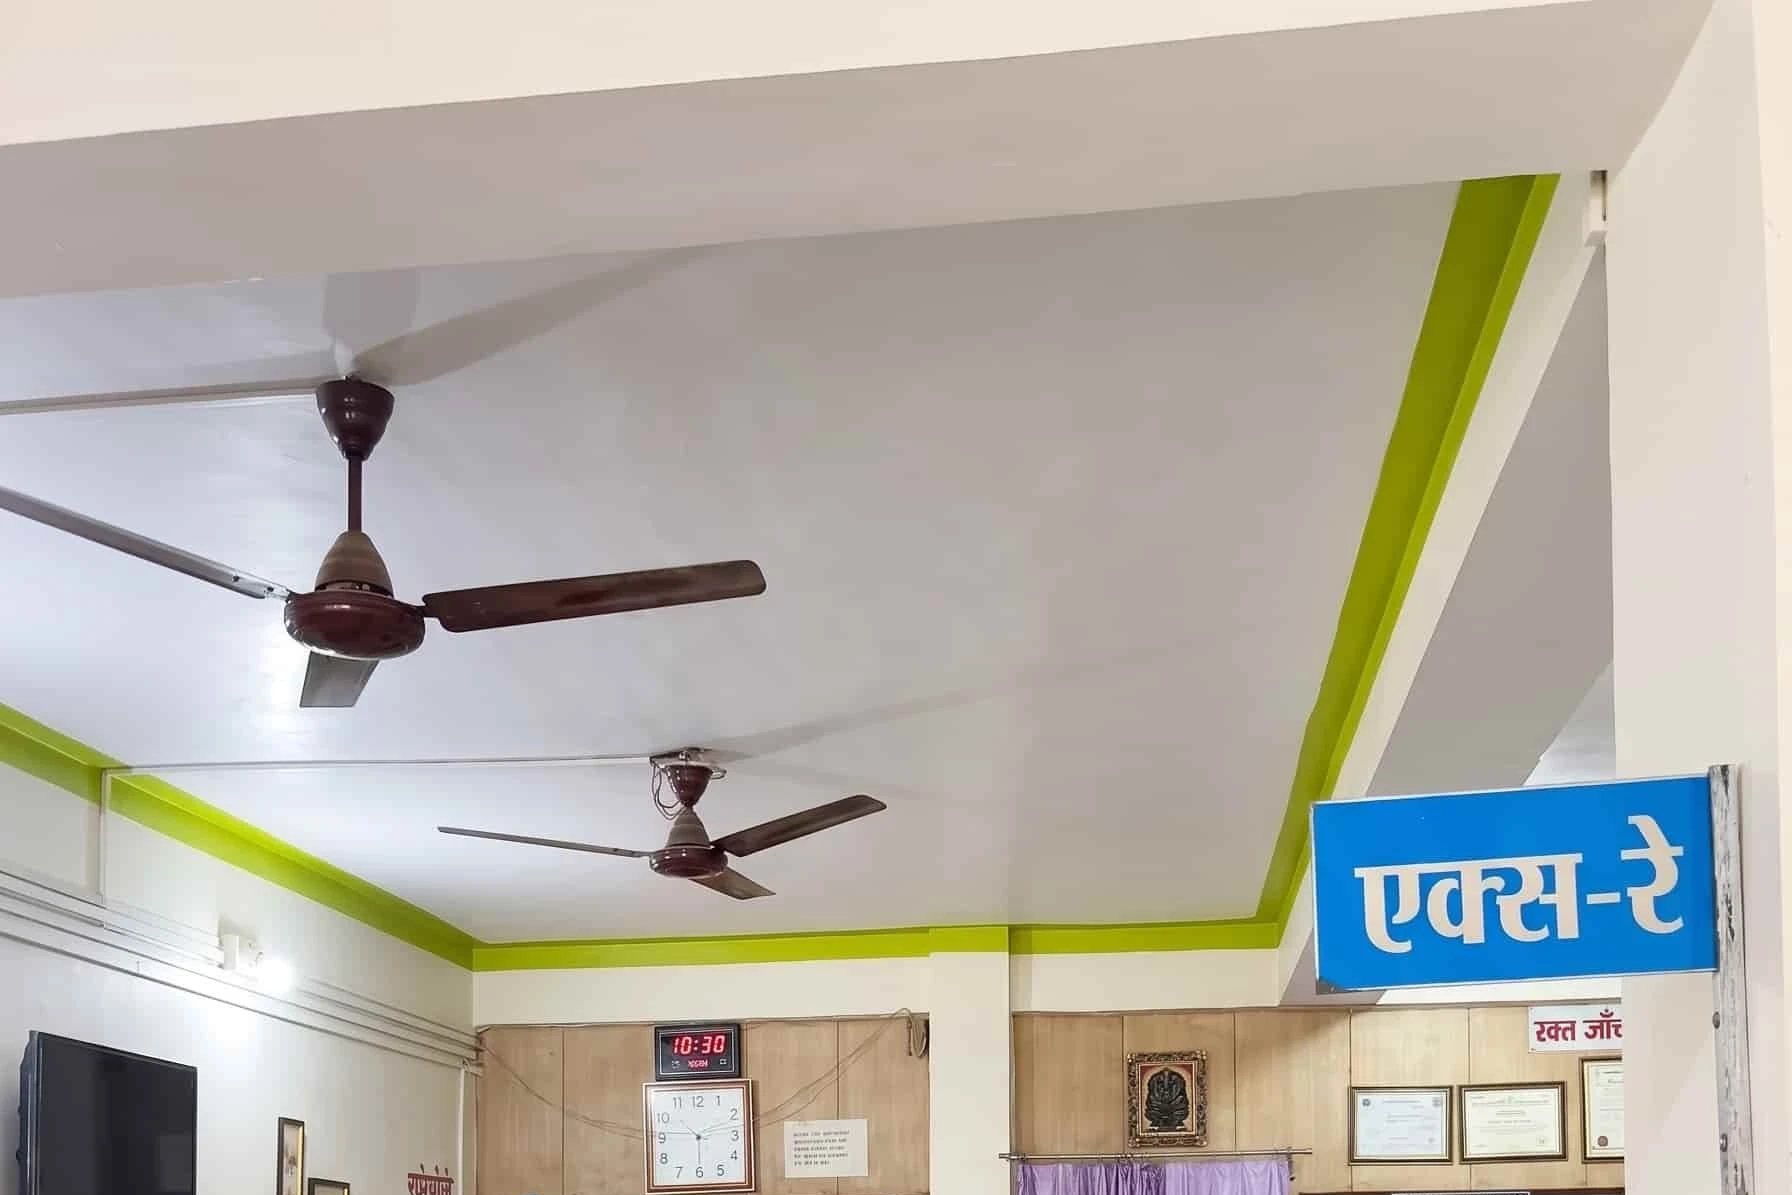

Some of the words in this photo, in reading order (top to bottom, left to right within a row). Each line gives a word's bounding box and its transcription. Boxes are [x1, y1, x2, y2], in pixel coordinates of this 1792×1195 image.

[1354, 814, 1684, 954] एक्स-रे
[1534, 1020, 1577, 1042] रक्त
[673, 1034, 726, 1055] 10:30
[673, 1096, 682, 1109] 11
[692, 1095, 705, 1109] 12
[657, 1112, 670, 1124] 10
[729, 1108, 739, 1121] 2
[658, 1132, 666, 1144] 9
[731, 1130, 740, 1141] 3
[660, 1152, 669, 1165] 8
[730, 1150, 738, 1160] 4
[674, 1166, 684, 1179] 7
[695, 1166, 704, 1178] 6
[716, 1164, 725, 1177] 5
